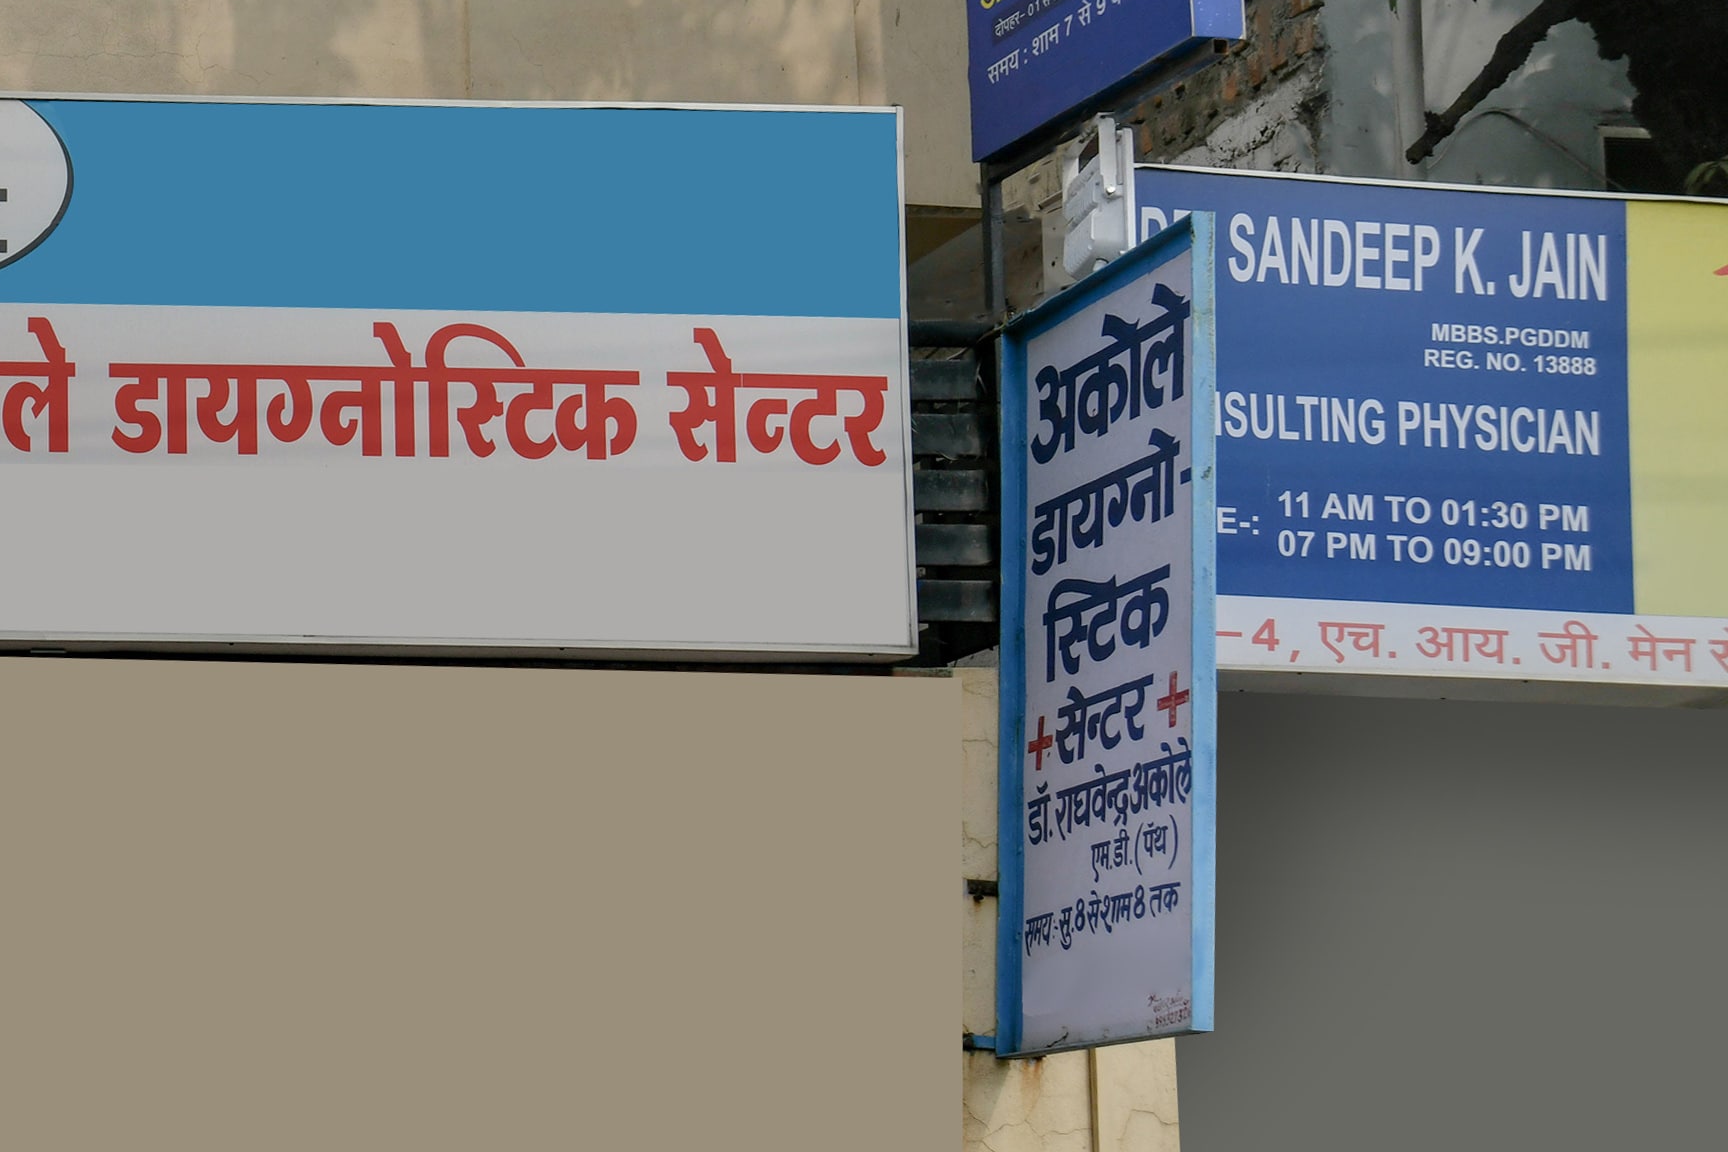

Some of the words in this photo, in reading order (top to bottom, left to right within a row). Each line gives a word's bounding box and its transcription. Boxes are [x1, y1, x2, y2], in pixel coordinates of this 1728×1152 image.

[1027, 0, 1040, 16] 01
[1031, 23, 1060, 56] शाम
[1064, 14, 1073, 37] 7
[1077, 0, 1092, 26] से
[1228, 213, 1440, 291] SANDEEP
[1455, 228, 1496, 295] K.
[1509, 231, 1608, 301] JAIN
[1424, 349, 1479, 369] REG.
[1486, 352, 1526, 372] NO.
[1533, 355, 1597, 376] 13888
[1431, 323, 1590, 349] MBBS.PGDDM
[109, 322, 639, 460] डायग्नोस्टिक
[667, 328, 888, 465] सेन्टर
[1030, 282, 1192, 465] अकोले
[1215, 391, 1386, 445] SULTING
[1398, 400, 1600, 456] PHYSICIAN
[1278, 490, 1309, 518] 11
[1321, 493, 1374, 521] AM
[1384, 496, 1433, 526] TO
[1441, 499, 1528, 530] 01:30
[1539, 504, 1590, 533] PM
[1278, 529, 1315, 557] 07
[1327, 532, 1376, 561] PM
[1387, 535, 1434, 564] TO
[1444, 539, 1530, 570] 09:00
[1541, 543, 1592, 572] PM
[1042, 563, 1170, 683] स्टिक
[1318, 621, 1397, 664] एच.
[1415, 625, 1522, 666] आय.
[1538, 620, 1611, 670] जी.
[1627, 624, 1696, 673] मेन
[1055, 673, 1154, 765] सेन्टर
[1028, 781, 1053, 846] डॉ.
[1055, 763, 1131, 841] राघवेन्द्र
[1130, 736, 1192, 814] अकोले
[1100, 892, 1133, 933] शाम
[1133, 884, 1146, 919] 8
[1149, 881, 1181, 917] तक
